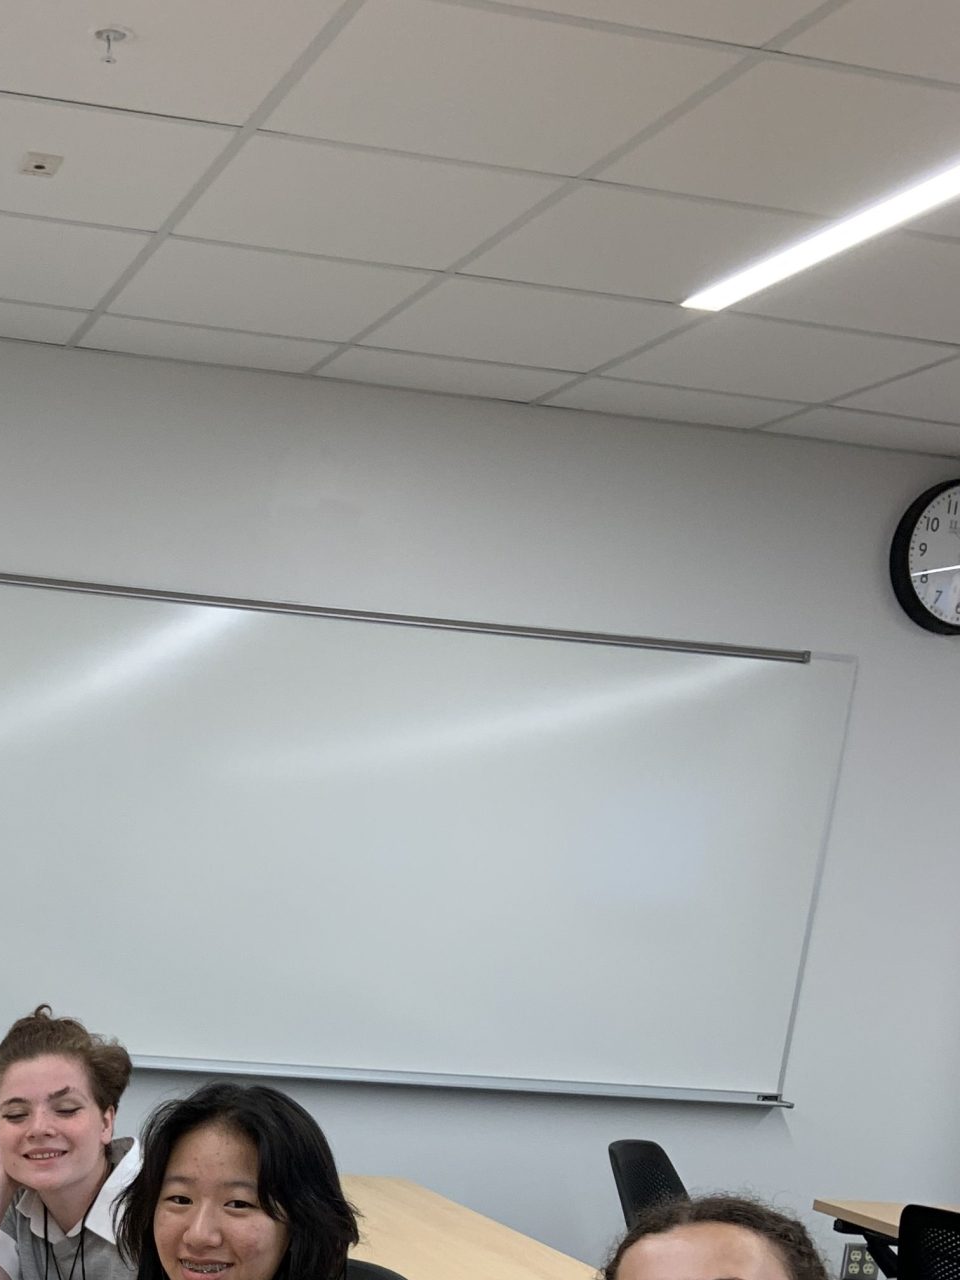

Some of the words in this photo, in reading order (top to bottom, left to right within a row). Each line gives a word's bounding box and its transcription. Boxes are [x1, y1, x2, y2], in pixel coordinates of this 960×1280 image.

[947, 499, 959, 515] 11
[926, 517, 939, 532] 10
[919, 543, 928, 556] 9
[935, 590, 942, 604] 7
